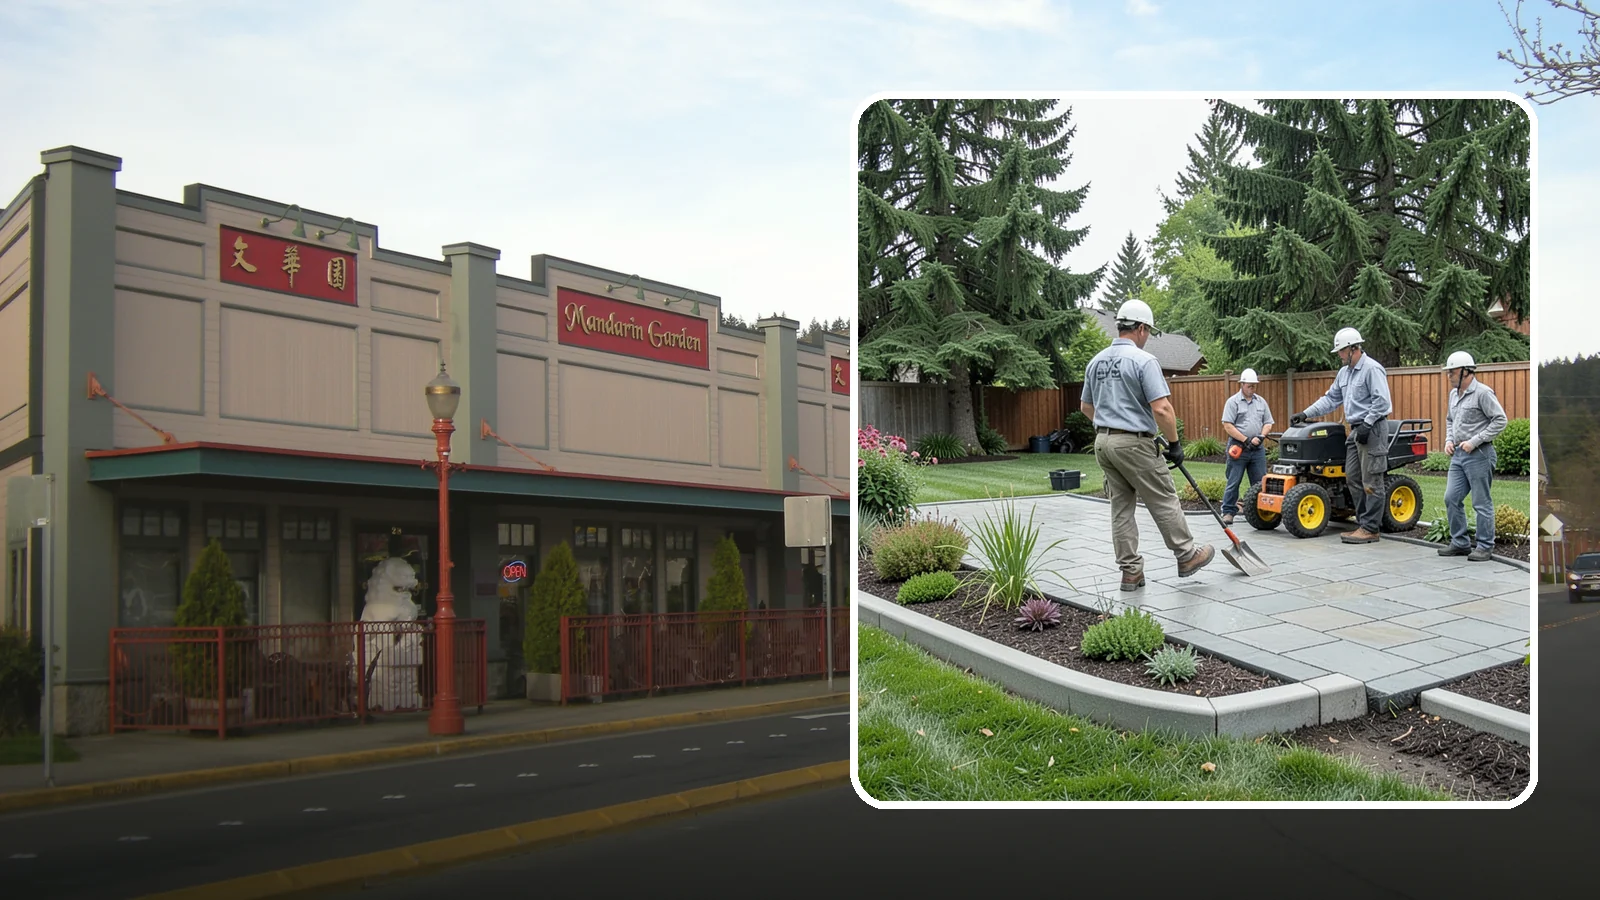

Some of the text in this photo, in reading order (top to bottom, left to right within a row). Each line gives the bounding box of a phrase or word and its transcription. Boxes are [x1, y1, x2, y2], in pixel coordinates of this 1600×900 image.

[565, 302, 701, 352] Mandarin Garden
[503, 565, 527, 578] OPEN
